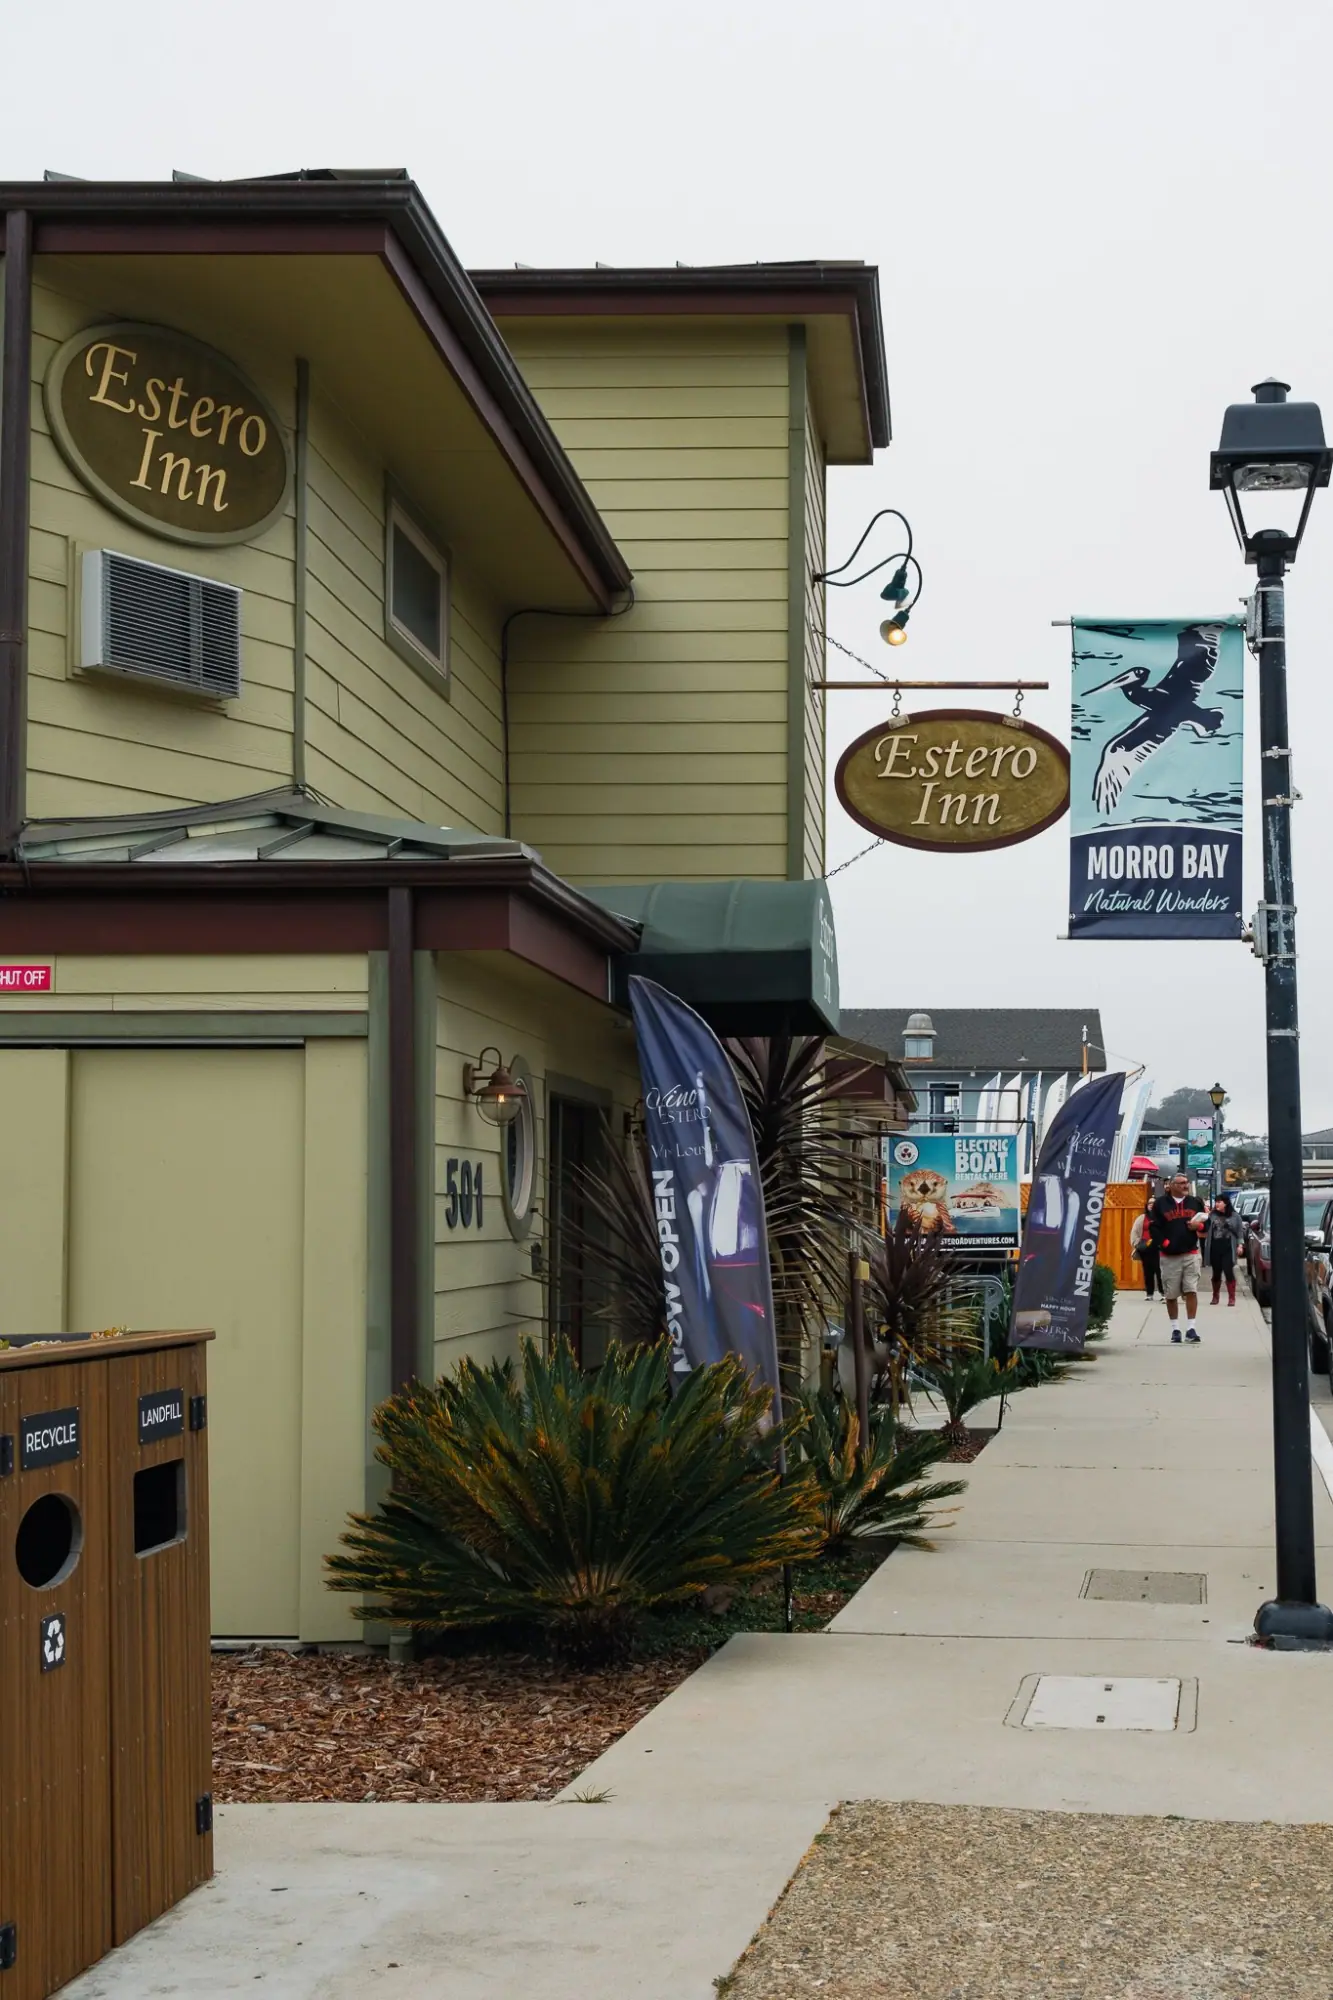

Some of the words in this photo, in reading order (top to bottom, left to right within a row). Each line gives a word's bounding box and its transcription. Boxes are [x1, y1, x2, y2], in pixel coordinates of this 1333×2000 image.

[85, 343, 267, 456] Estero
[129, 428, 229, 512] Inn
[874, 734, 1038, 779] Estero
[911, 782, 1002, 825] Inn
[1087, 844, 1174, 880] MORRO
[1182, 844, 1230, 879] BAY
[1083, 888, 1155, 913] Natural
[1155, 888, 1230, 913] Wonders
[24, 970, 46, 985] OFF
[645, 1084, 697, 1110] Vino
[658, 1105, 711, 1125] ESTERO
[955, 1139, 1008, 1153] ELECTRIC
[955, 1152, 1008, 1173] BOAT
[955, 1172, 987, 1181] RENTALS
[988, 1172, 1008, 1180] HERE
[445, 1159, 483, 1230] 501
[1084, 1181, 1106, 1236] NOW
[652, 1169, 680, 1273] OPEN
[940, 1236, 1015, 1246] STEROADVENTURES.COM
[1074, 1238, 1096, 1297] OPEN
[663, 1279, 692, 1372] NOW
[141, 1402, 182, 1428] LANDFILL
[26, 1423, 77, 1453] RECYCLE
